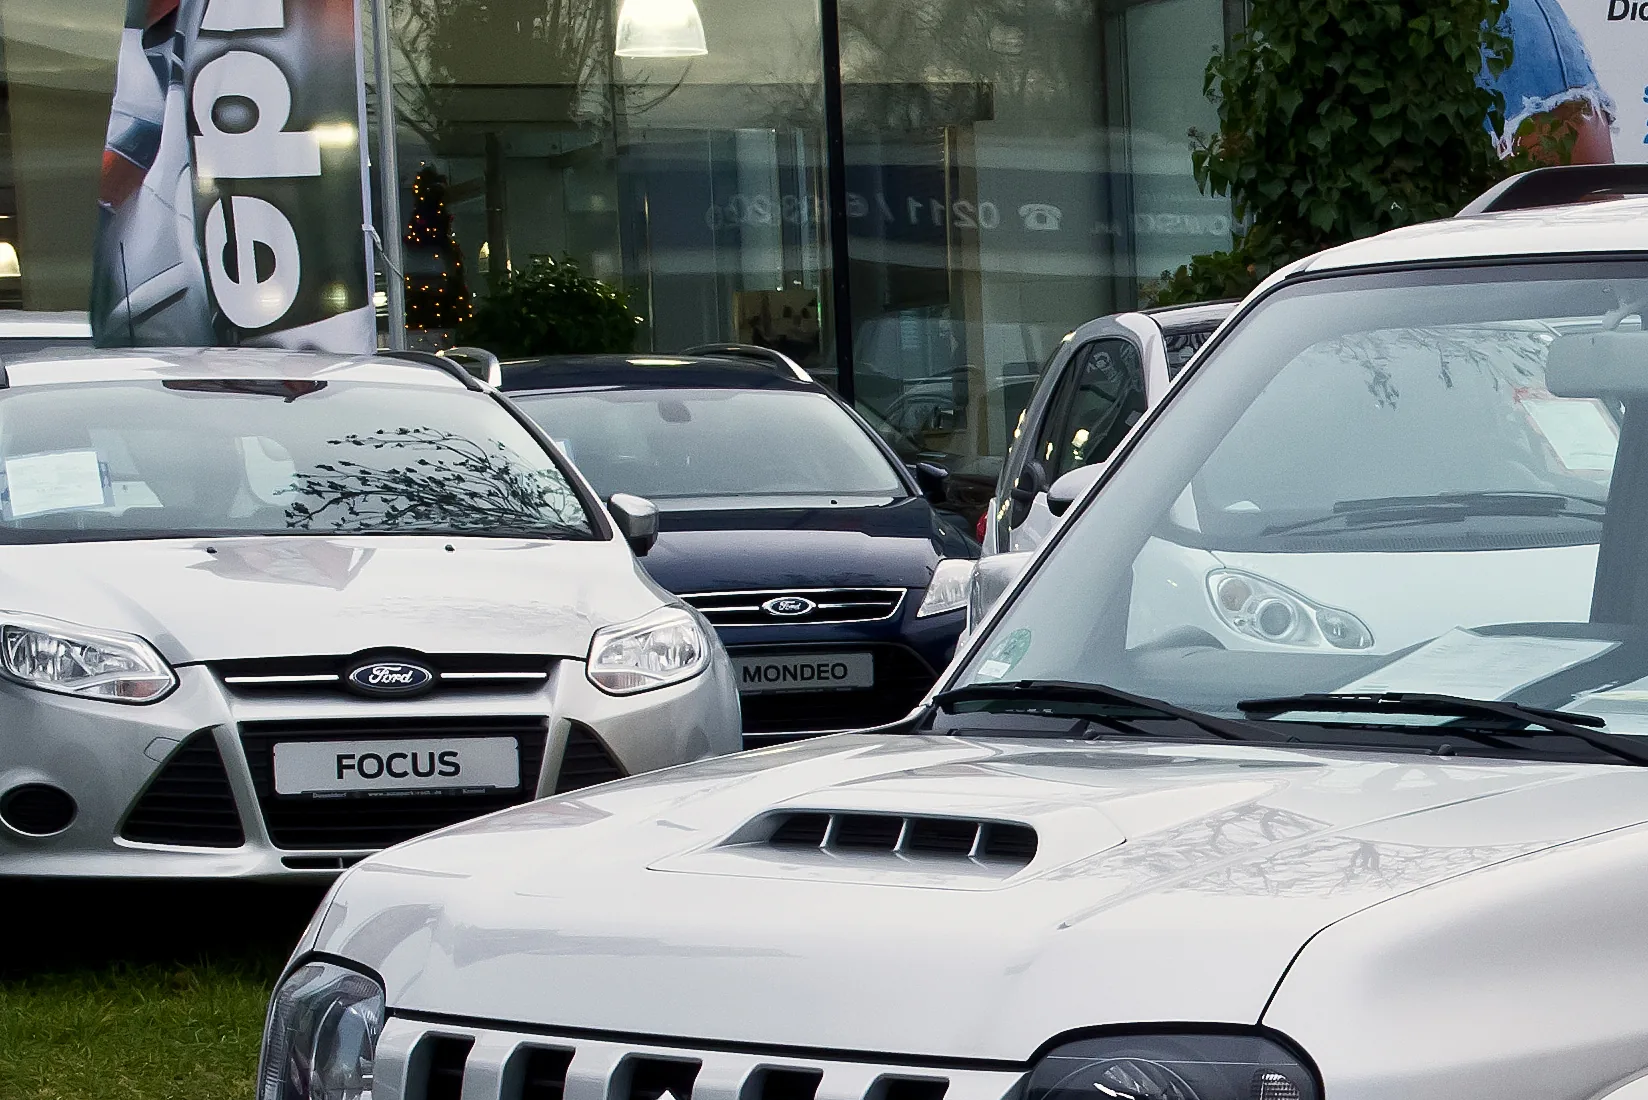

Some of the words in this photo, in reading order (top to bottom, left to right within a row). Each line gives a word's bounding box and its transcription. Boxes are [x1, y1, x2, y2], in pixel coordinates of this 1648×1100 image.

[368, 665, 414, 684] Ford
[742, 662, 848, 683] MONDEO
[336, 751, 461, 780] FOCUS
